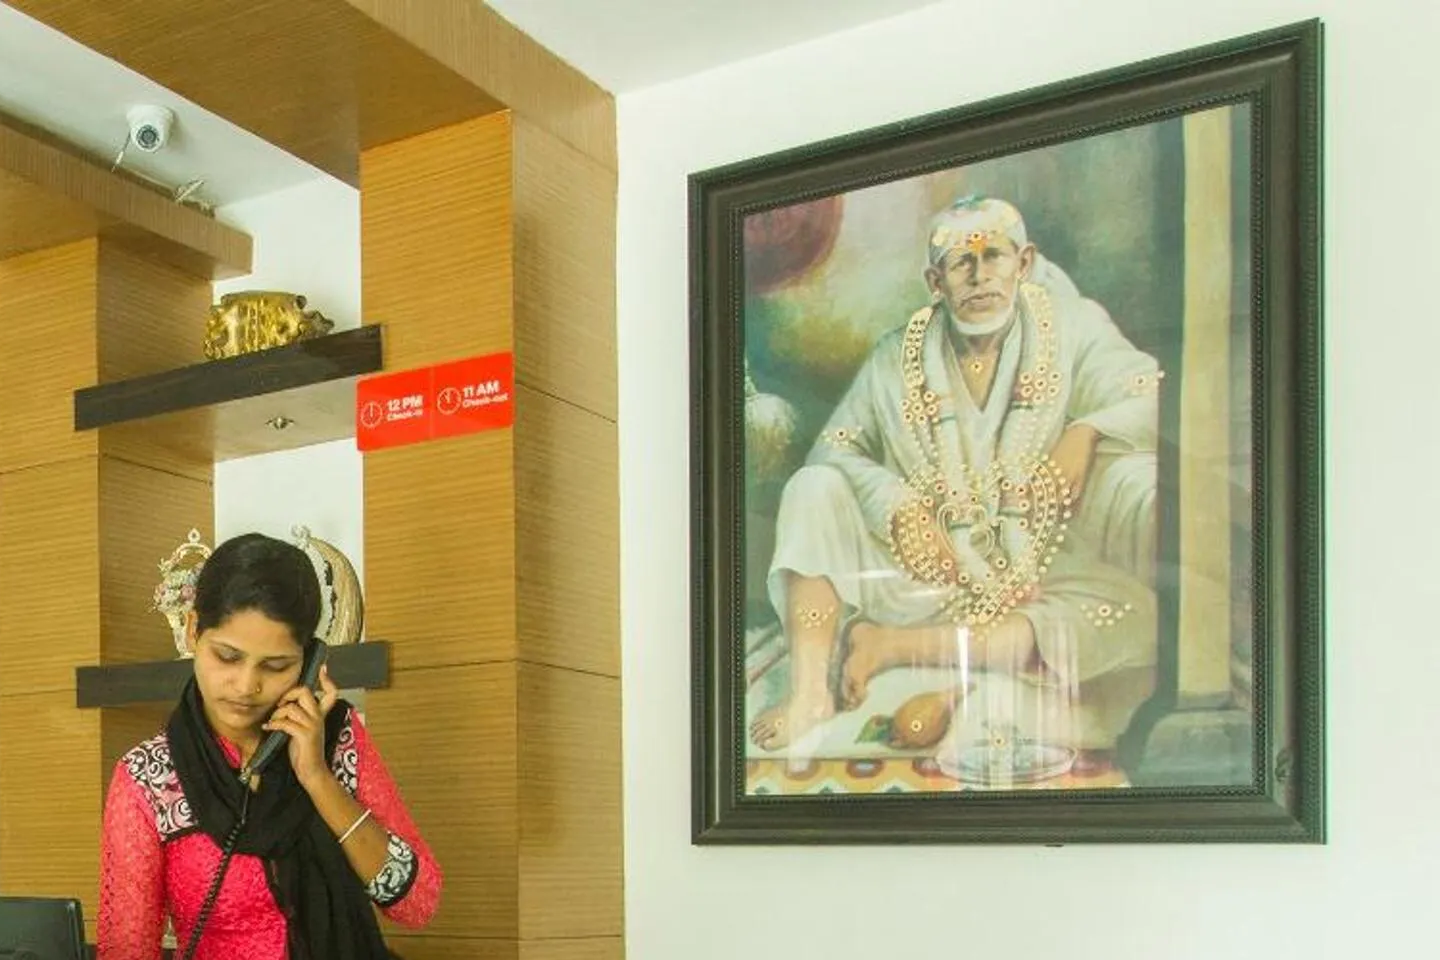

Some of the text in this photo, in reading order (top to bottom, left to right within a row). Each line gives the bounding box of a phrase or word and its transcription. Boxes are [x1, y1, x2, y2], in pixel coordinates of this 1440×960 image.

[462, 379, 500, 398] 11 AM
[386, 395, 423, 412] 12 PM
